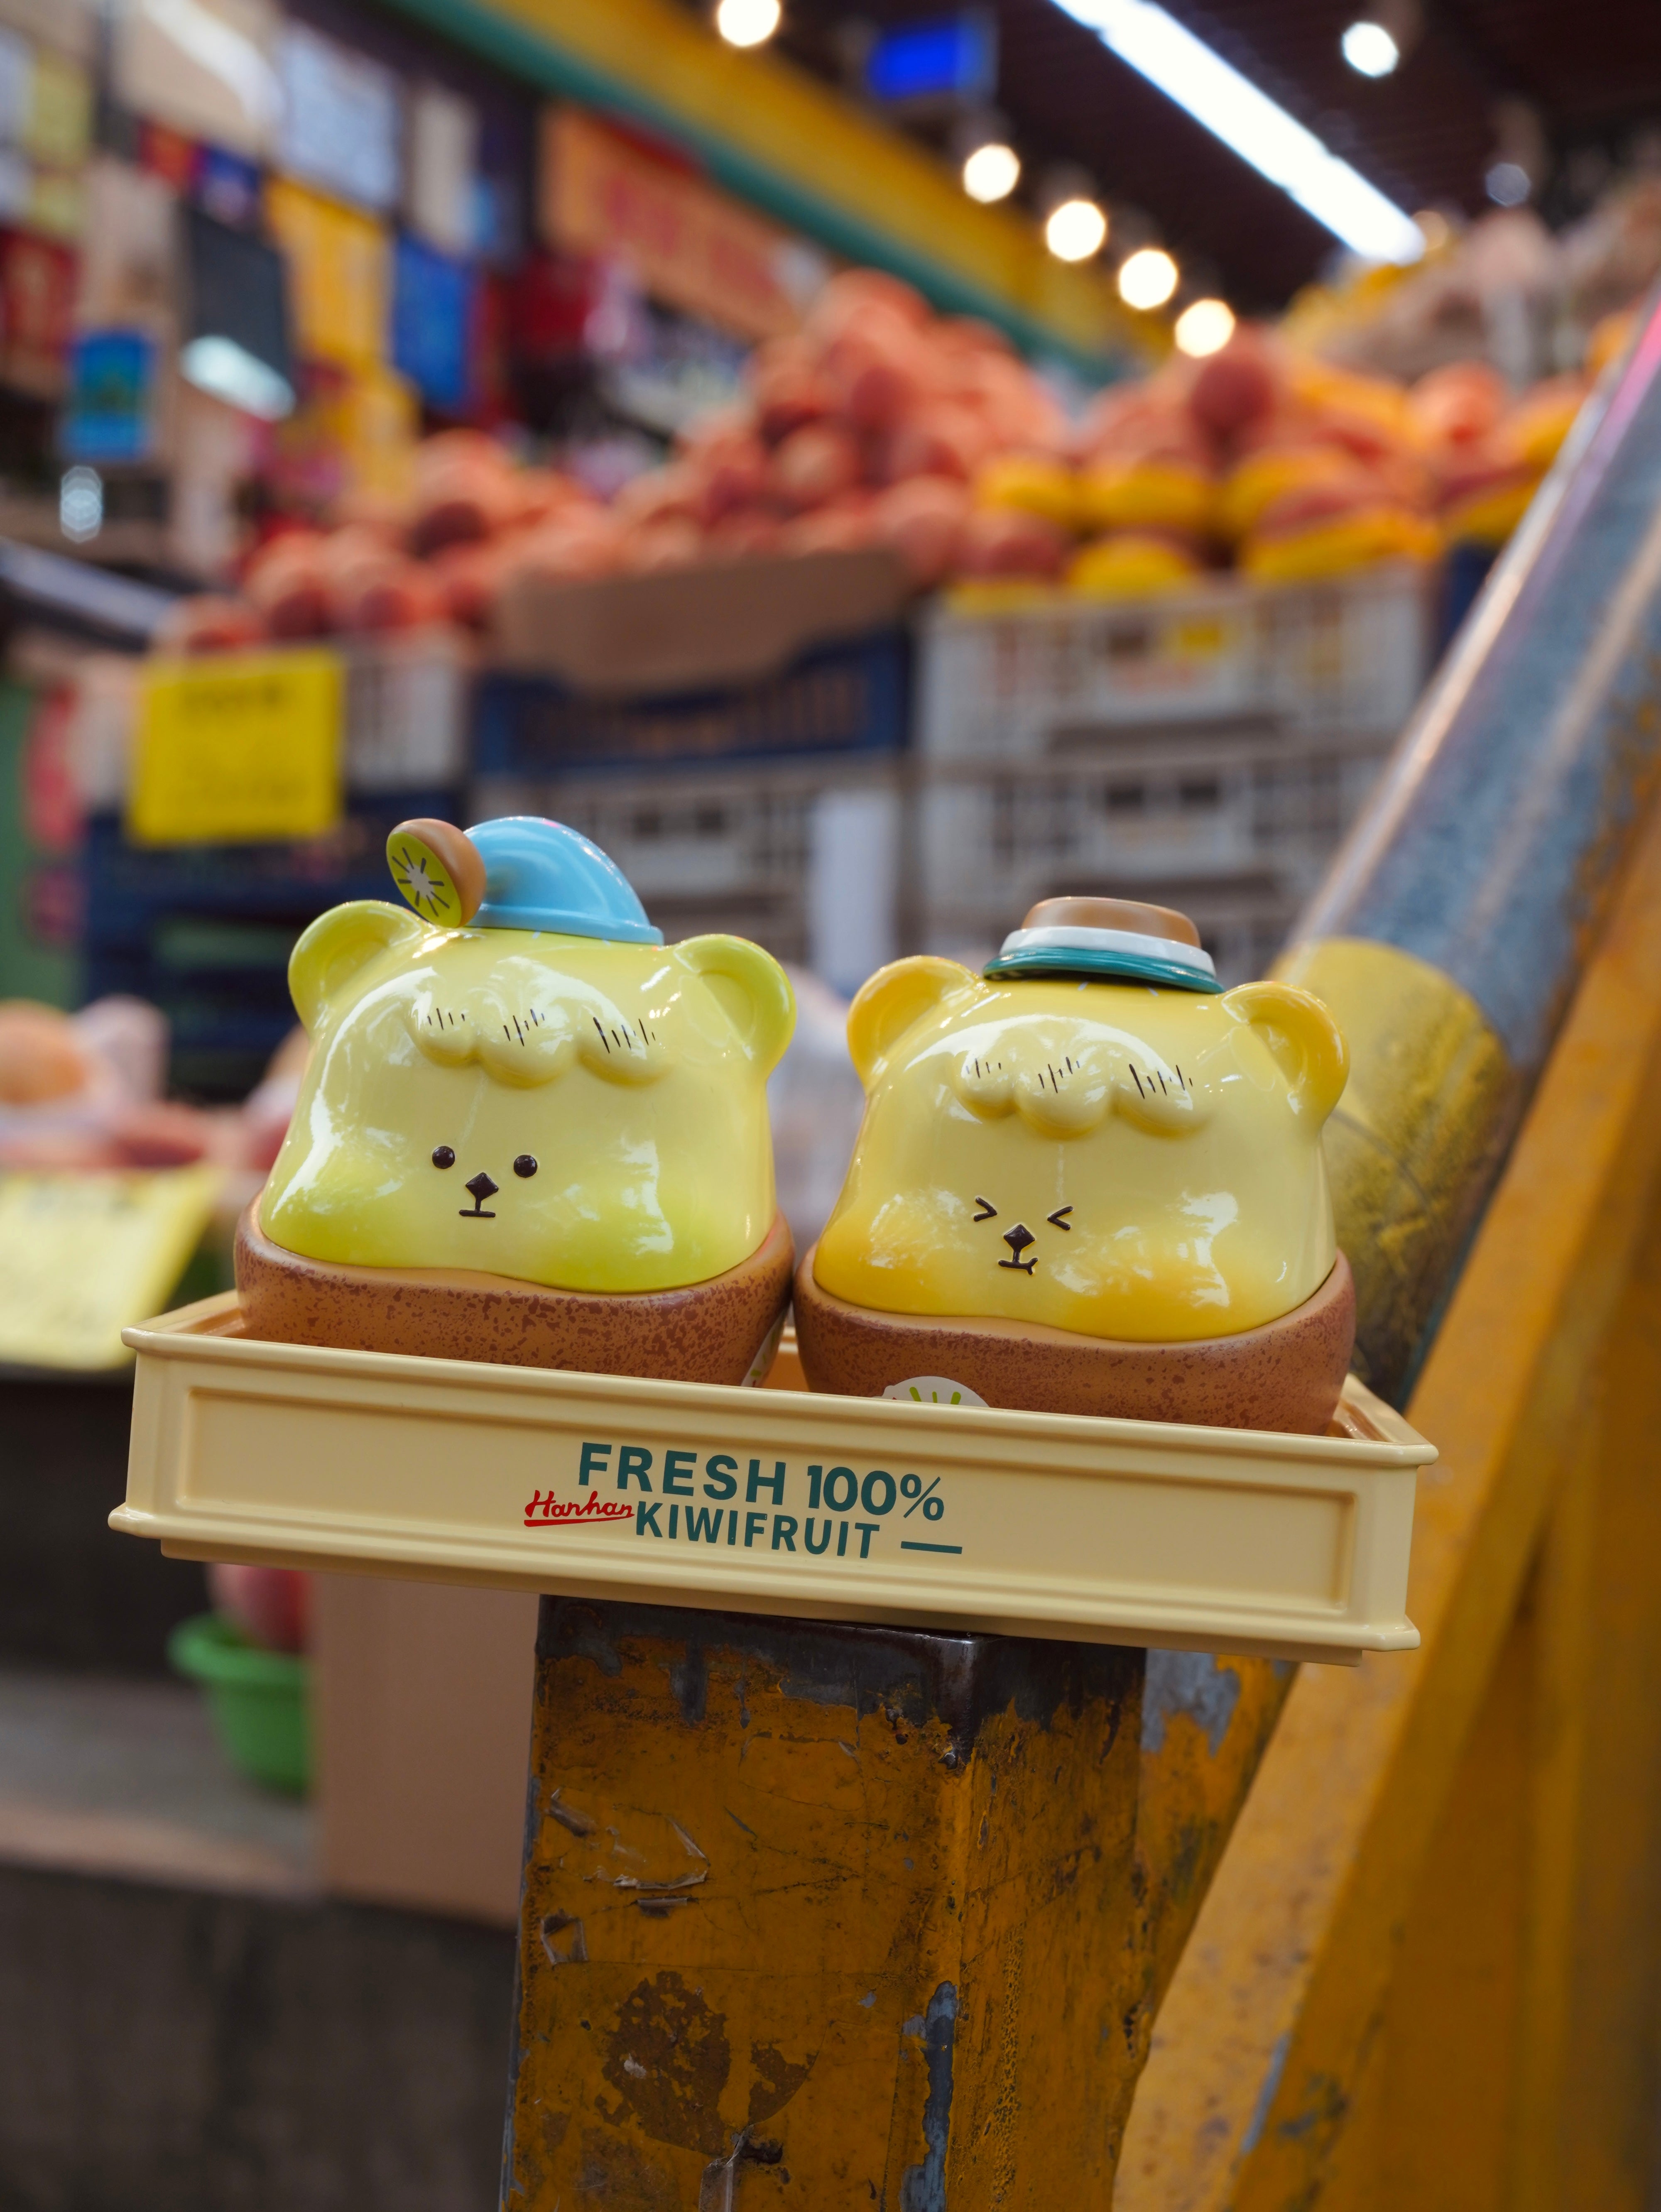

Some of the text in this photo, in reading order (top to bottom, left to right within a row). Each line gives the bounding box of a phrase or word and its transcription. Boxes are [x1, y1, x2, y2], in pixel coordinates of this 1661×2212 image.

[524, 1489, 635, 1520] Hanhan
[578, 1442, 945, 1521] FRESH 100%
[636, 1500, 880, 1559] KIWIFRUIT
